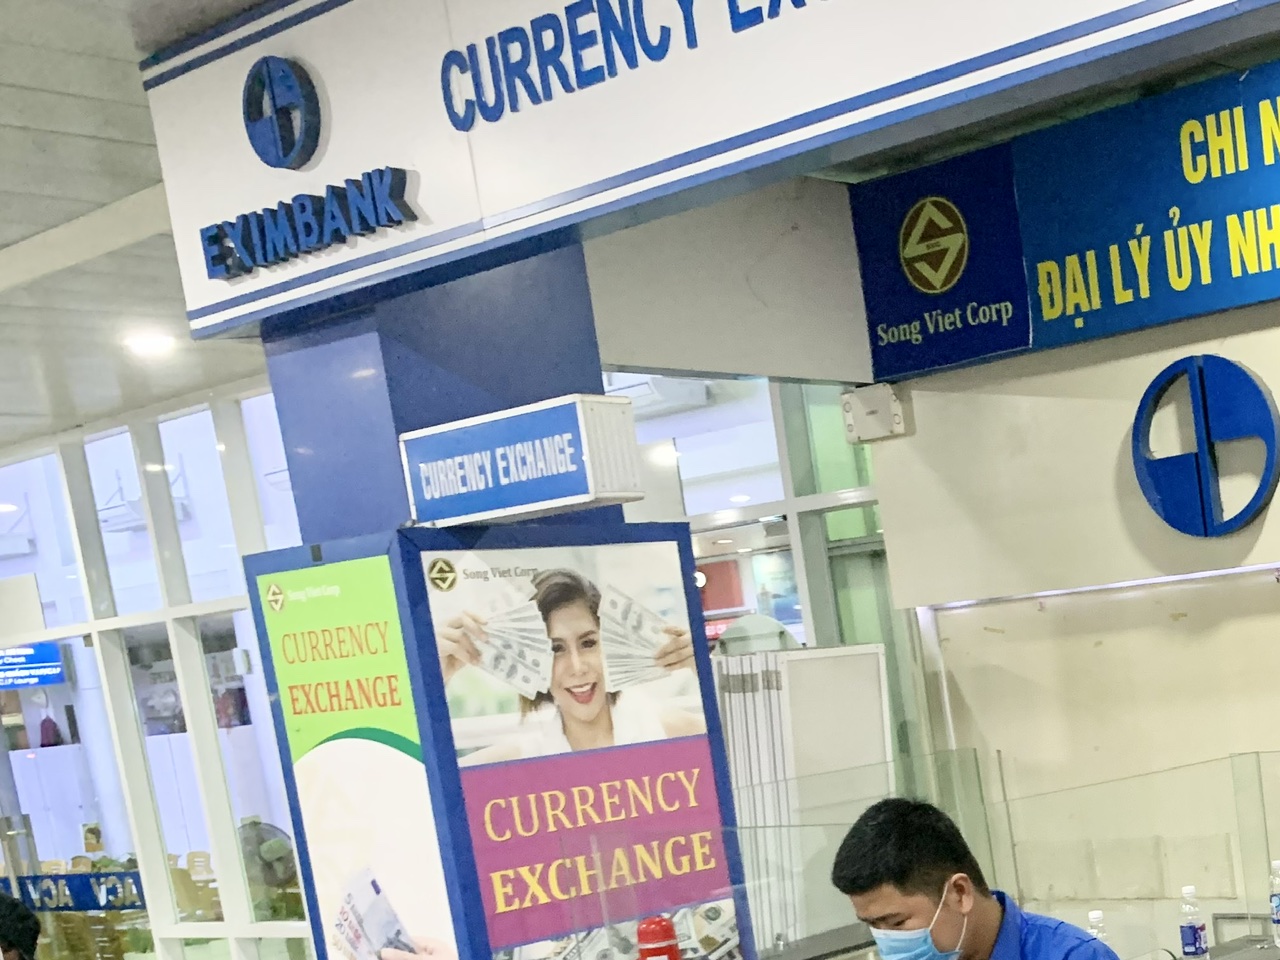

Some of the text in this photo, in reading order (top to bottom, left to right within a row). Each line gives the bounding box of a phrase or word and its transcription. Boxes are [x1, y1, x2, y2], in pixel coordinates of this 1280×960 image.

[441, 0, 699, 132] CURRENCY
[1179, 106, 1249, 184] CHI
[200, 166, 412, 279] EXIMBANK
[1037, 249, 1102, 328] ĐẠI
[1110, 223, 1151, 306] LÝ
[1165, 207, 1213, 291] ỦY
[876, 299, 1013, 346] Song Viet Corp
[419, 433, 578, 500] CURRENCY EXCHANGE
[463, 568, 490, 582] Song
[490, 567, 513, 578] Viet
[281, 621, 389, 665] CURRENCY
[288, 675, 402, 715] EXCHANGE
[483, 768, 700, 842] CURRENCY
[490, 831, 716, 914] EXCHANGE
